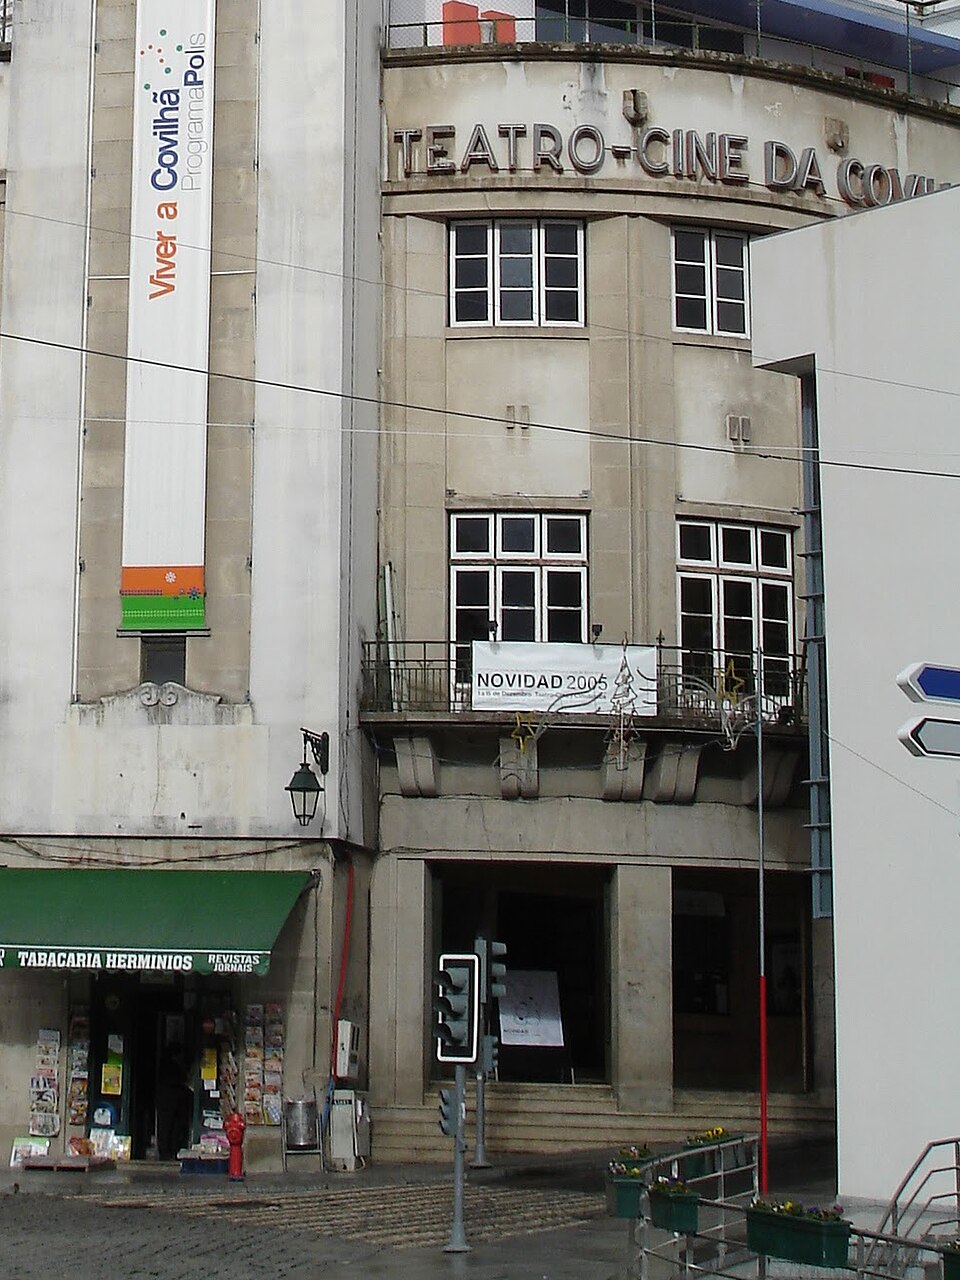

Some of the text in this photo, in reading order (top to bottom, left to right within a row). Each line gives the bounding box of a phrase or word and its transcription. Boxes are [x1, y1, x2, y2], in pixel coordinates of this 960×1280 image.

[394, 123, 749, 184] TEATRO-CINE
[764, 140, 827, 196] DA
[148, 87, 181, 301] Viver a Covilhã
[477, 673, 608, 691] NOVIDAD 2005
[17, 951, 193, 970] TABACARIA HERMINIOS
[208, 954, 260, 965] REVISTAS
[213, 963, 253, 973] JORNAIS
